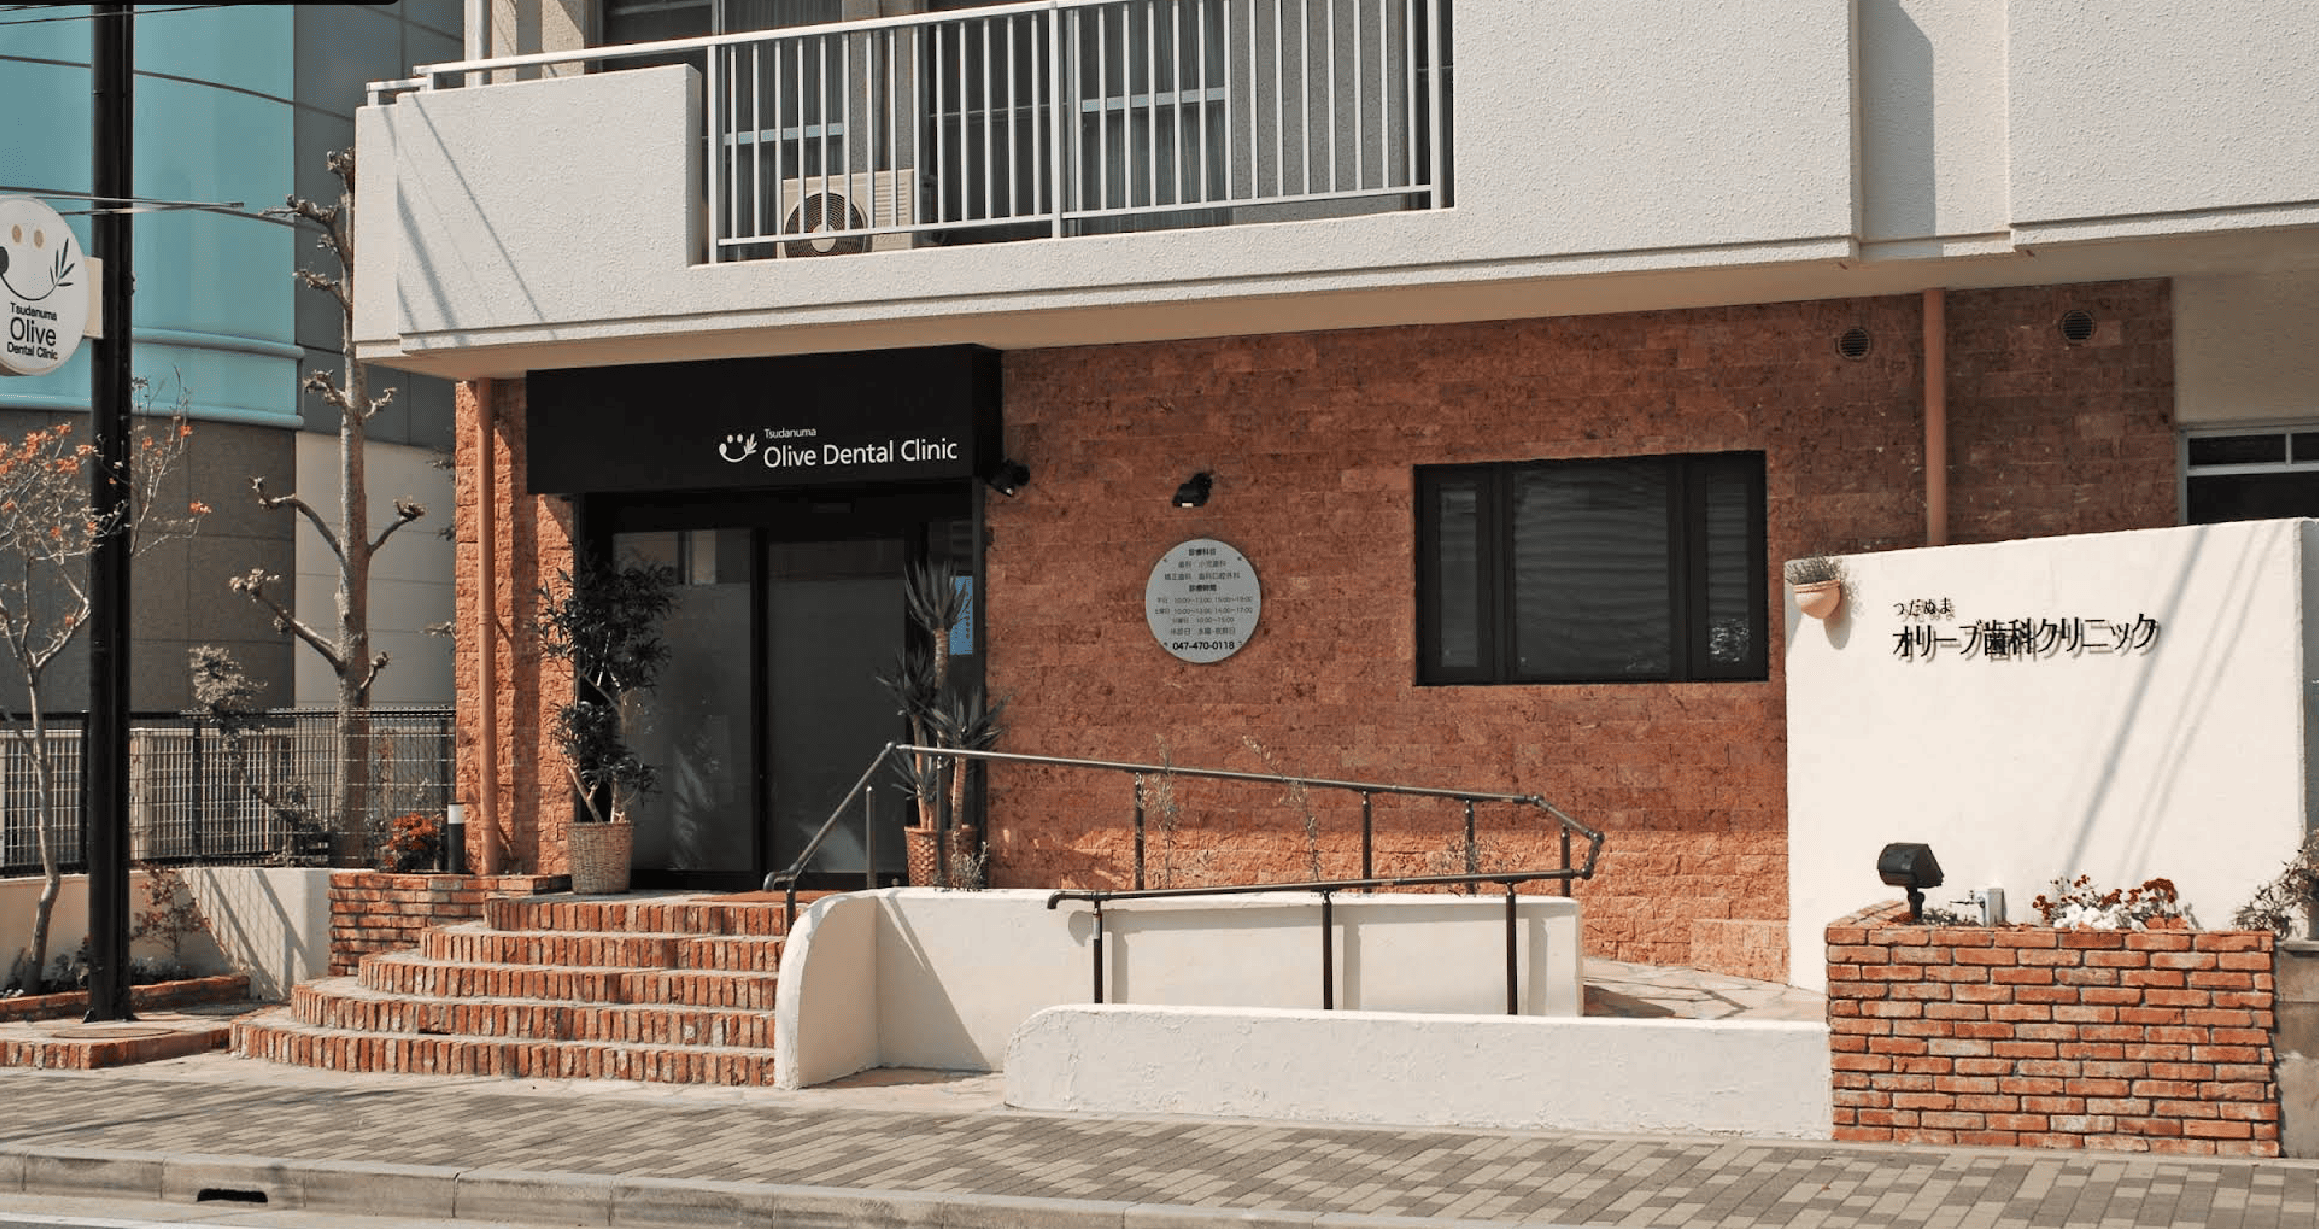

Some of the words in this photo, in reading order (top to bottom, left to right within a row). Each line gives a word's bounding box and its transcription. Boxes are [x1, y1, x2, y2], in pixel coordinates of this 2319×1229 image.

[10, 301, 58, 321] Tsudanuma
[10, 317, 57, 347] Olive
[7, 341, 35, 356] Dental
[36, 346, 58, 361] Clinic
[764, 428, 816, 439] Tsudanuma
[764, 445, 816, 468] Olive
[823, 440, 894, 465] Dental
[901, 438, 957, 462] Clinic
[1893, 597, 1950, 616] つだぬま
[1893, 613, 2158, 657] オリーブ歯科クリニック
[1172, 642, 1235, 650] 047-470-0118
